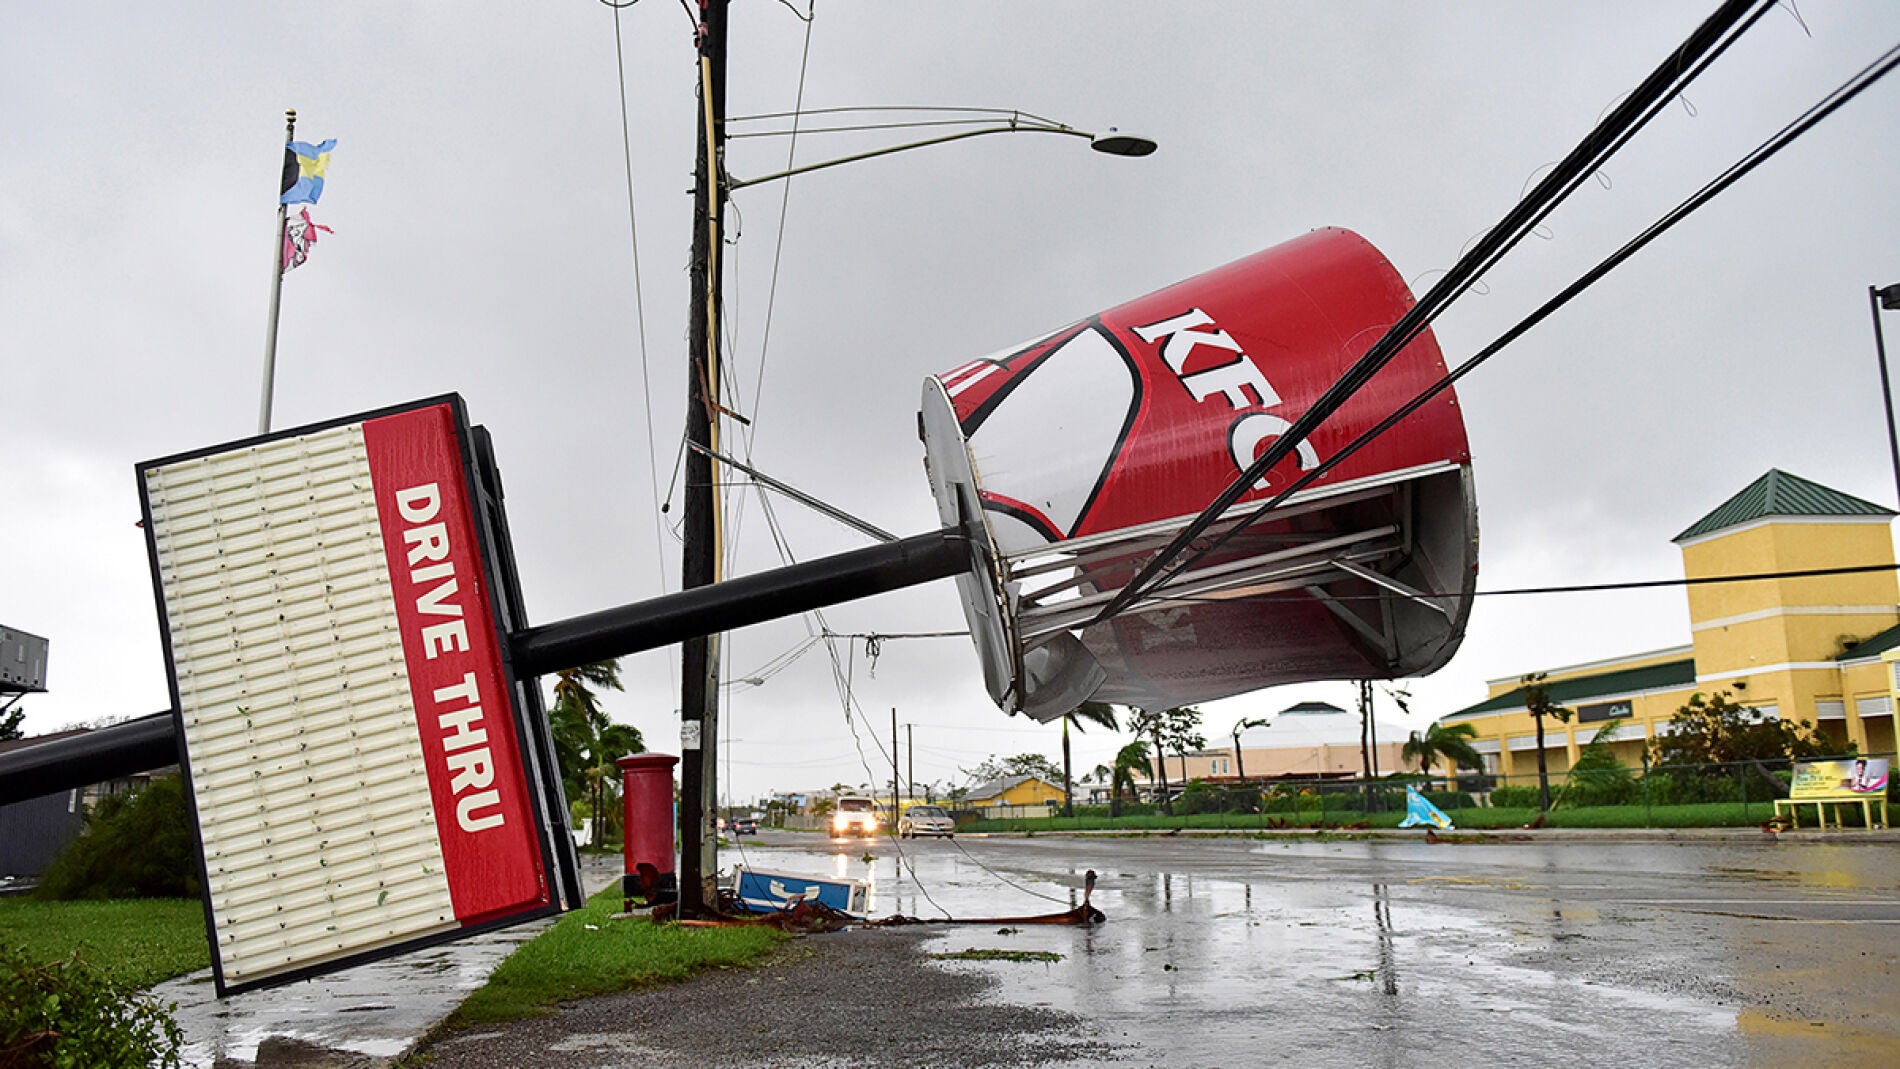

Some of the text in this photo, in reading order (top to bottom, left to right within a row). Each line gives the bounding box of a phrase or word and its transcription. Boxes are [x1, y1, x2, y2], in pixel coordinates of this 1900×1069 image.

[1130, 308, 1321, 490] KFC
[395, 482, 505, 833] DRIVE THRU
